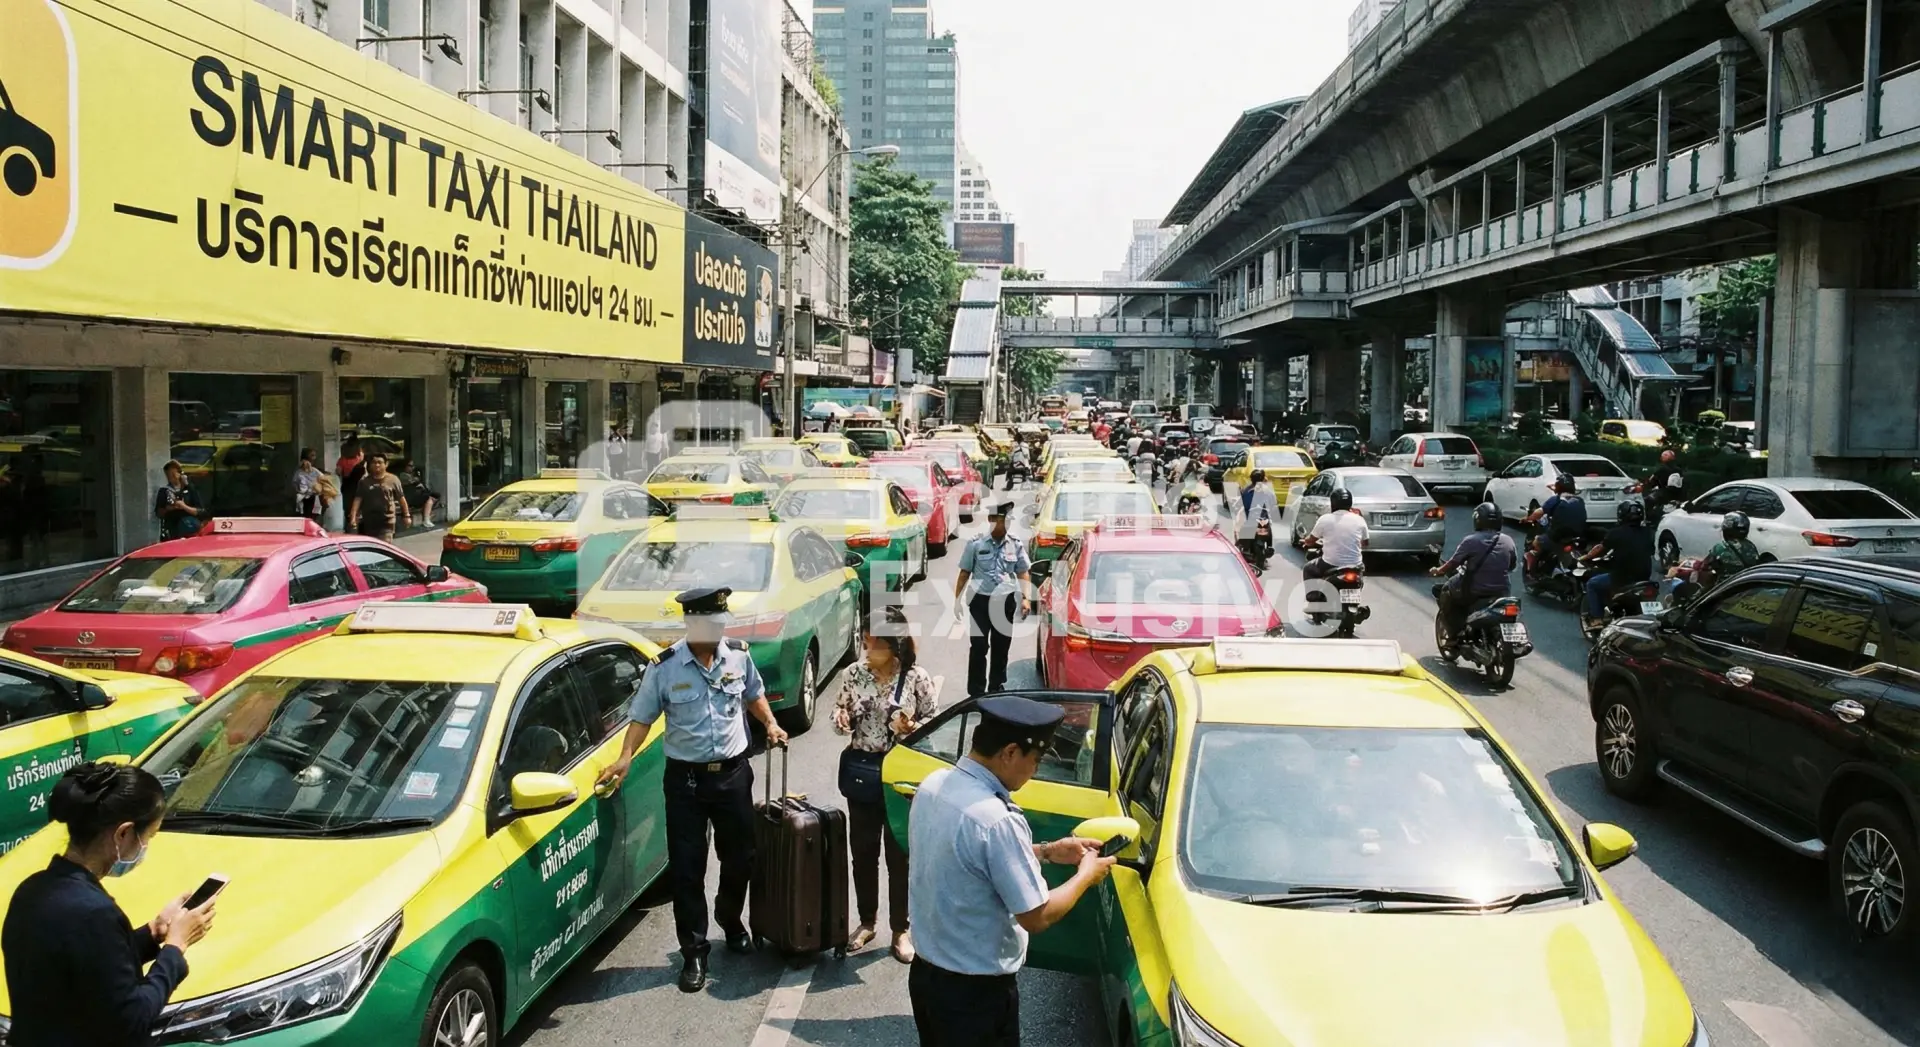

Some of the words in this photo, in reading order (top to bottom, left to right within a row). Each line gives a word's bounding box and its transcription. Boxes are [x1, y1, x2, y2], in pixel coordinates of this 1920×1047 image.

[190, 55, 407, 197] SMART
[419, 137, 510, 230] TAXI
[521, 175, 658, 271] THAILAND
[197, 188, 603, 319] บริการเรียกแท็กซี่ผ่านแอปฯ
[609, 284, 629, 323] 24
[634, 294, 657, 328] ชม.
[695, 240, 747, 298] ปลอดภัย
[695, 297, 746, 345] ประทับใจ
[29, 793, 46, 812] 24
